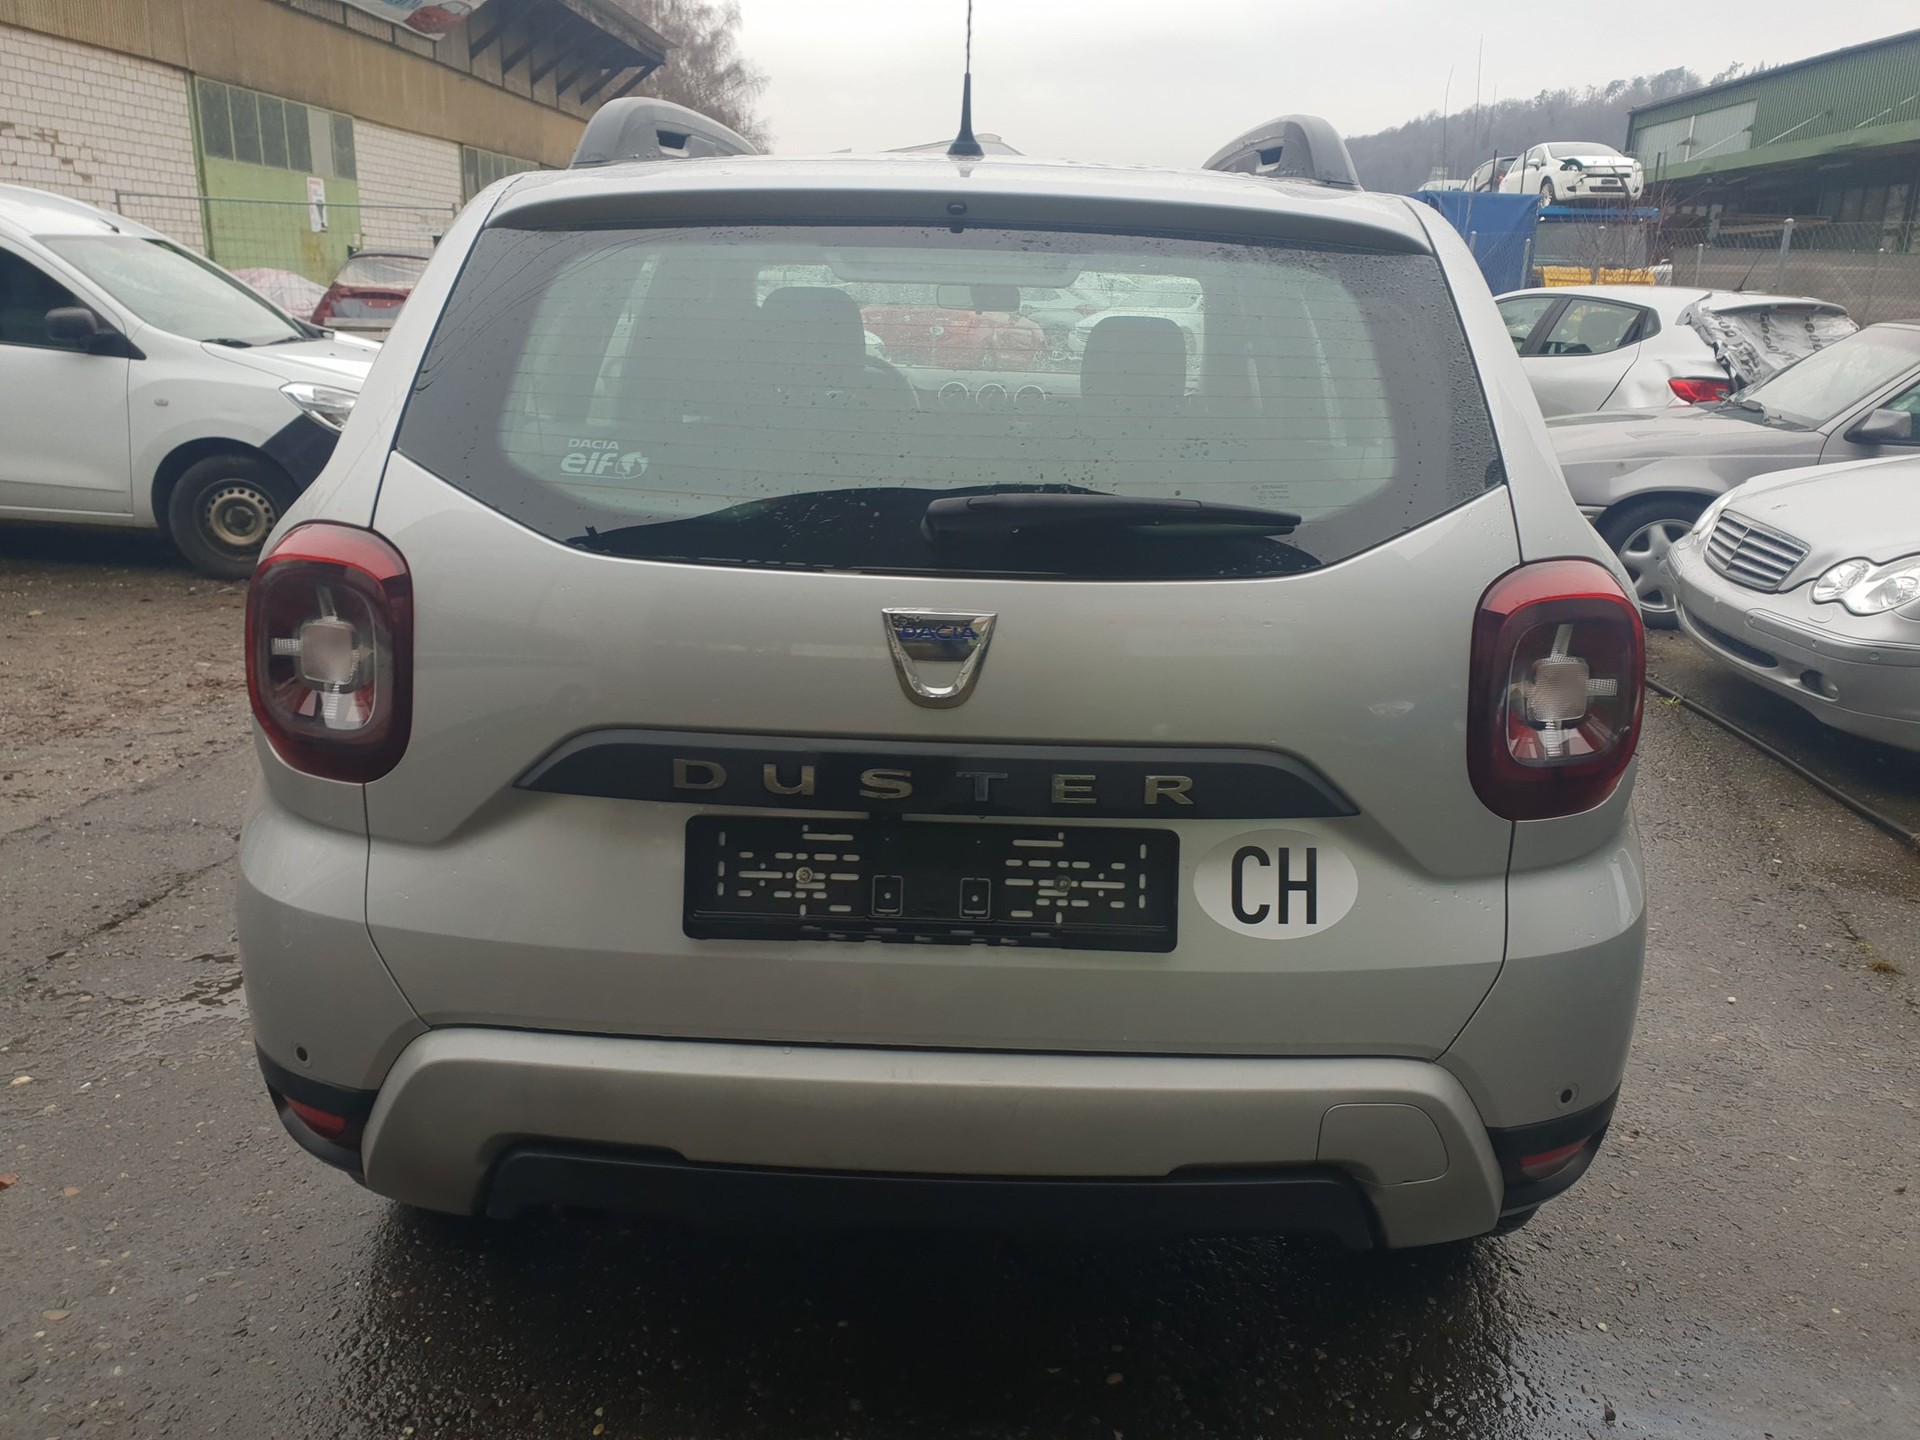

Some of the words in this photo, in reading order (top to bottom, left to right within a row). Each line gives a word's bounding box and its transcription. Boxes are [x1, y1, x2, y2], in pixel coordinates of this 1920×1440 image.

[567, 438, 619, 450] DACIA
[560, 451, 618, 475] elf
[899, 624, 980, 640] DACIA
[672, 758, 1195, 805] DUSTER
[1231, 845, 1318, 925] CH
